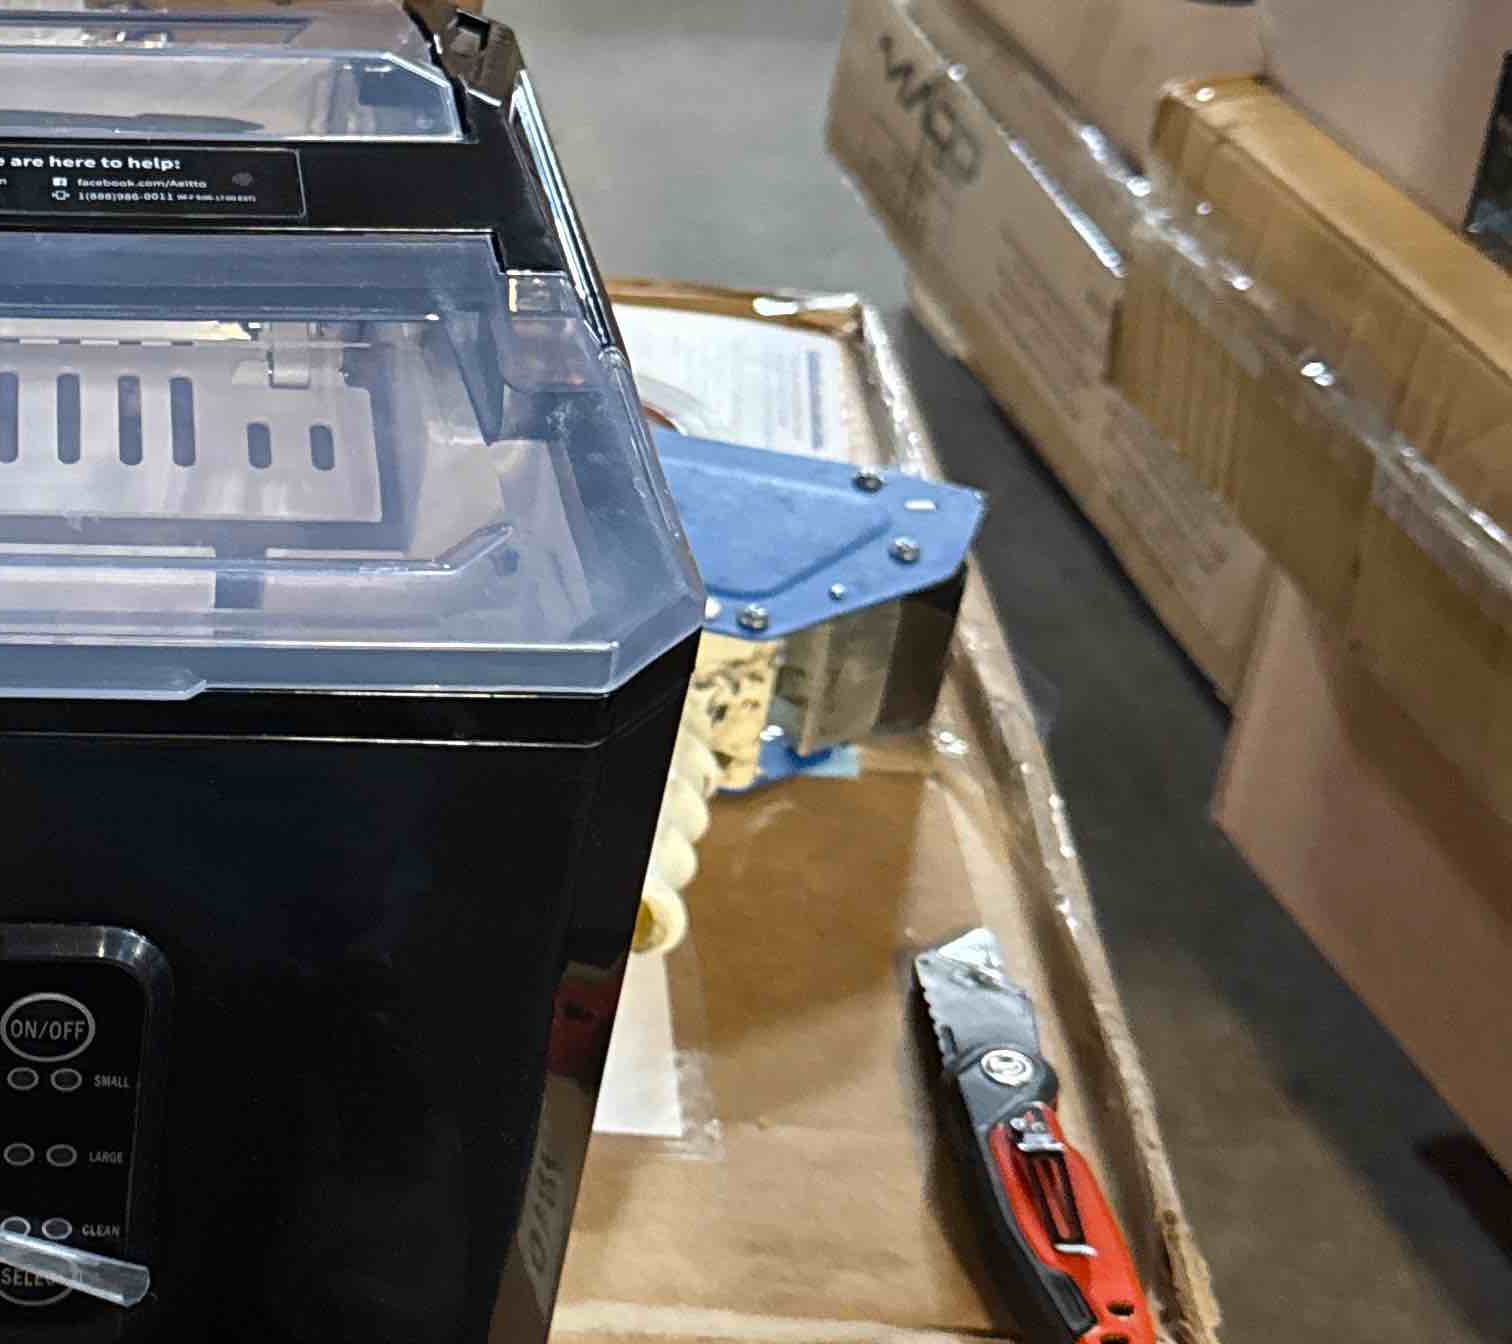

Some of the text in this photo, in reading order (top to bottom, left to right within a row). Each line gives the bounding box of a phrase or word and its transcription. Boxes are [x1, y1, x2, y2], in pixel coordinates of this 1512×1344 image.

[10, 157, 44, 167] are
[49, 156, 97, 169] here
[101, 157, 123, 169] to
[128, 157, 181, 171] help:
[10, 1018, 86, 1041] ON/OFF
[94, 1074, 130, 1088] SMALL
[89, 1151, 123, 1165] LARGE
[82, 1223, 120, 1237] CLEAN
